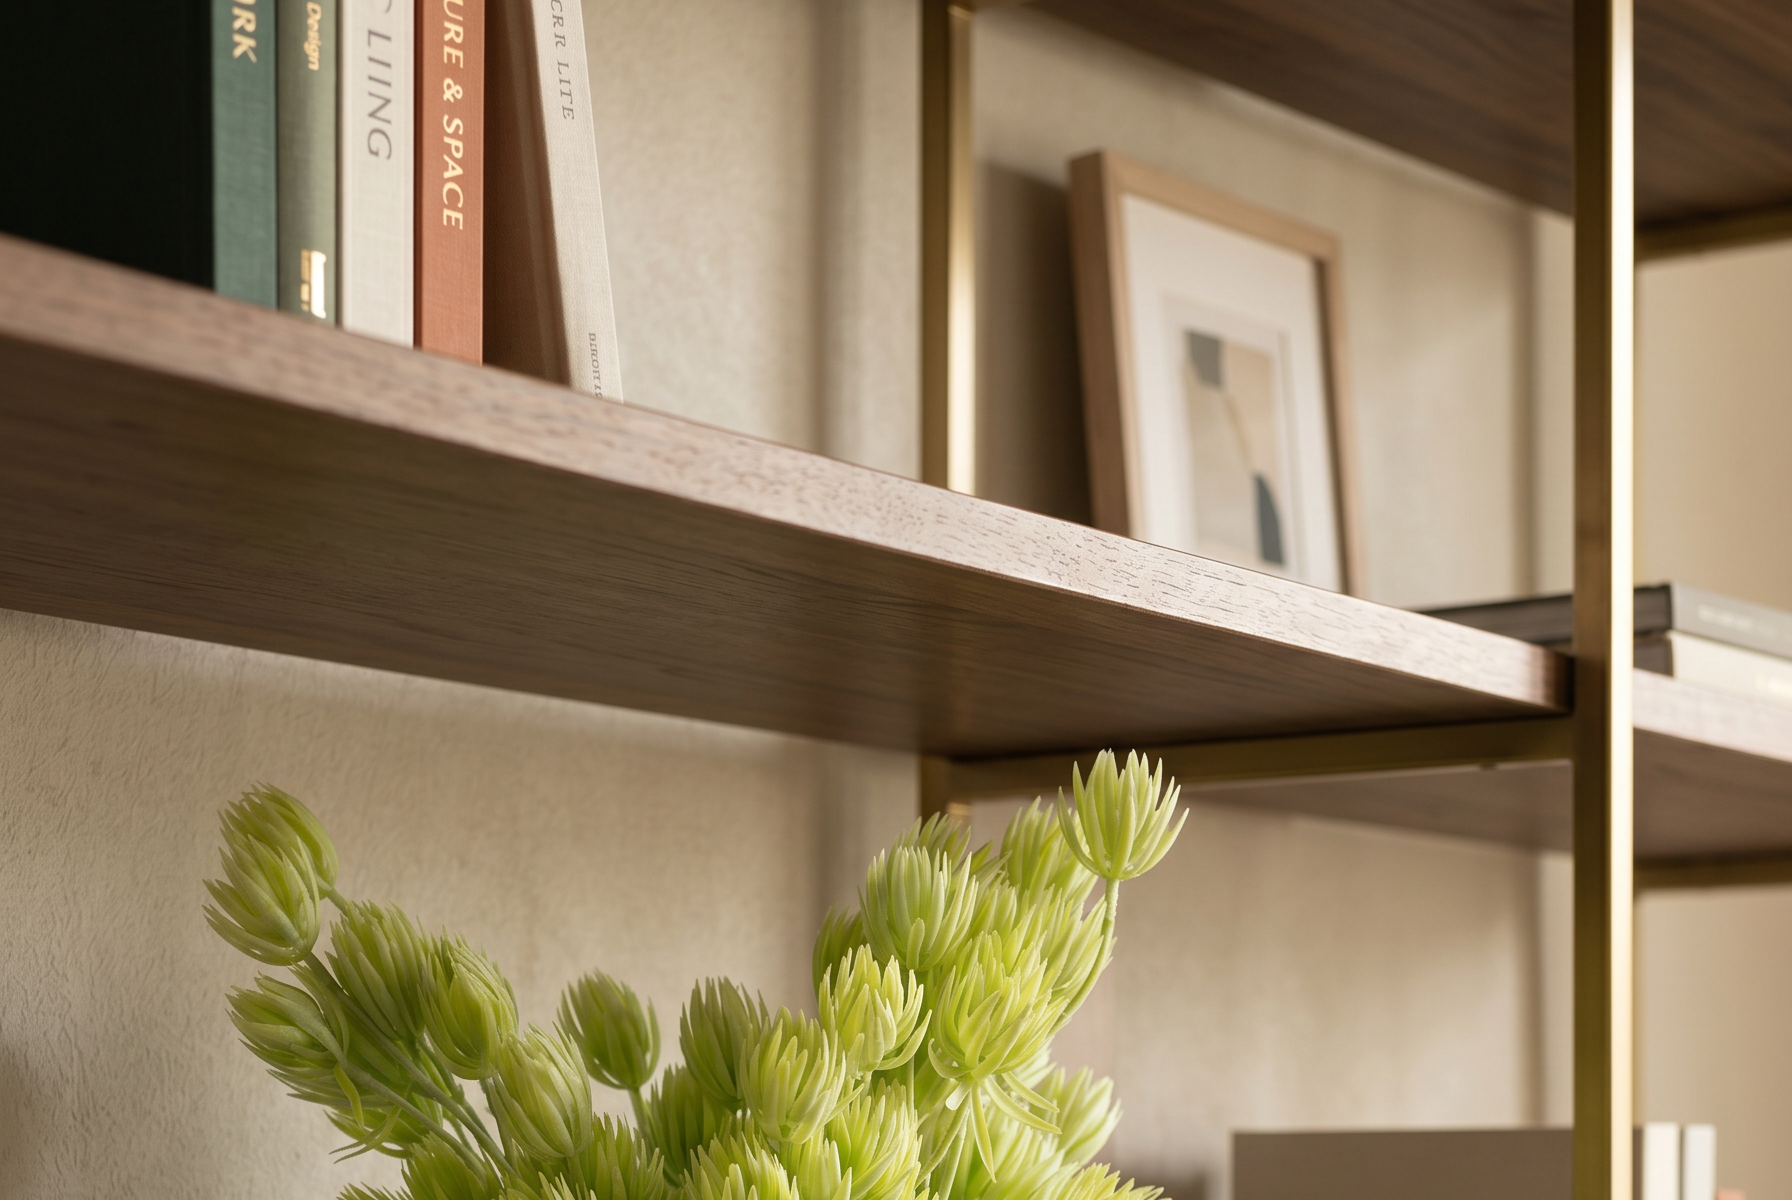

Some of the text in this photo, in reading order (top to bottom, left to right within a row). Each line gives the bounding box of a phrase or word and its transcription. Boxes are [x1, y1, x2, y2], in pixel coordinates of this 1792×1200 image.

[303, 2, 322, 71] Design
[443, 78, 463, 103] &
[557, 60, 575, 120] LITE
[443, 114, 464, 230] SPACE
